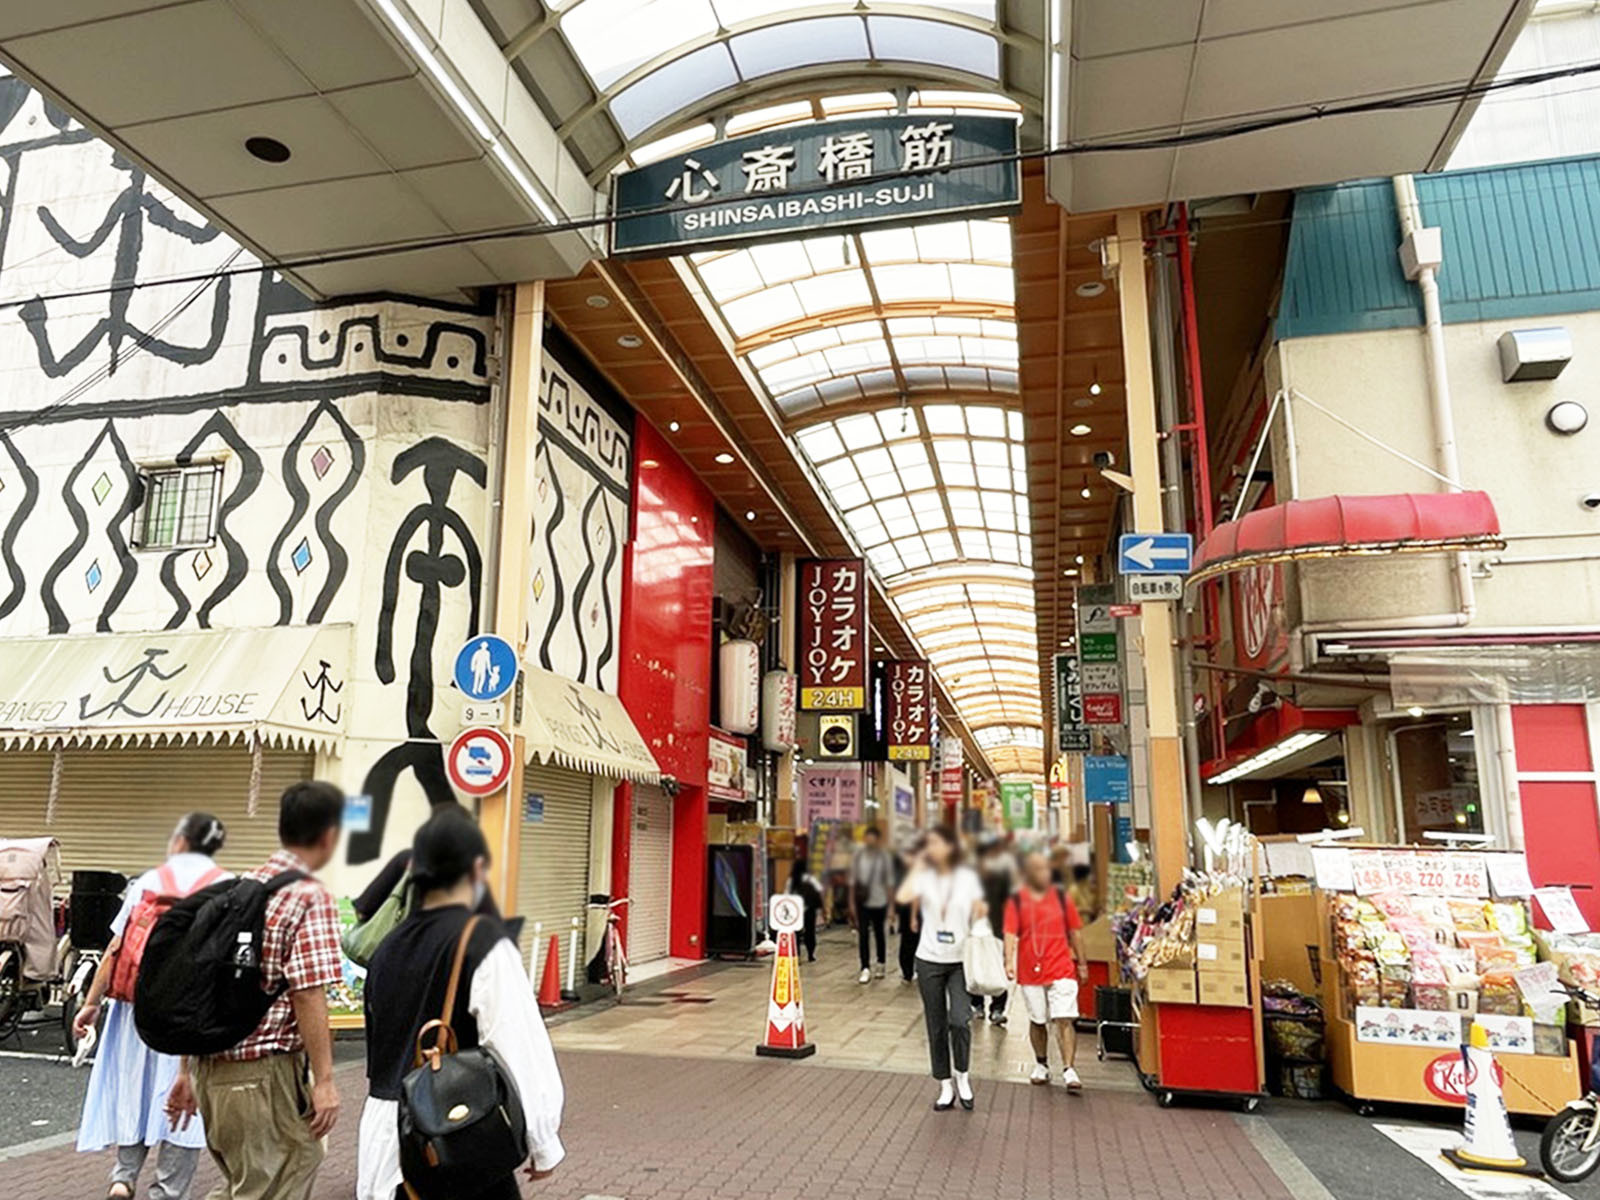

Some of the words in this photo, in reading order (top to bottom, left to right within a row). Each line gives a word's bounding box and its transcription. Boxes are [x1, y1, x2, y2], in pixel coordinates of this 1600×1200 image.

[665, 121, 955, 202] 心斎橋筋
[683, 183, 935, 231] SHINSAIBASHI-SUJI
[808, 566, 828, 684] JOYJOY
[830, 566, 857, 683] カラオケ
[160, 693, 258, 718] HOUSE
[811, 690, 854, 707] 24H
[907, 665, 926, 744] カラオケ
[1418, 872, 1444, 887] 220
